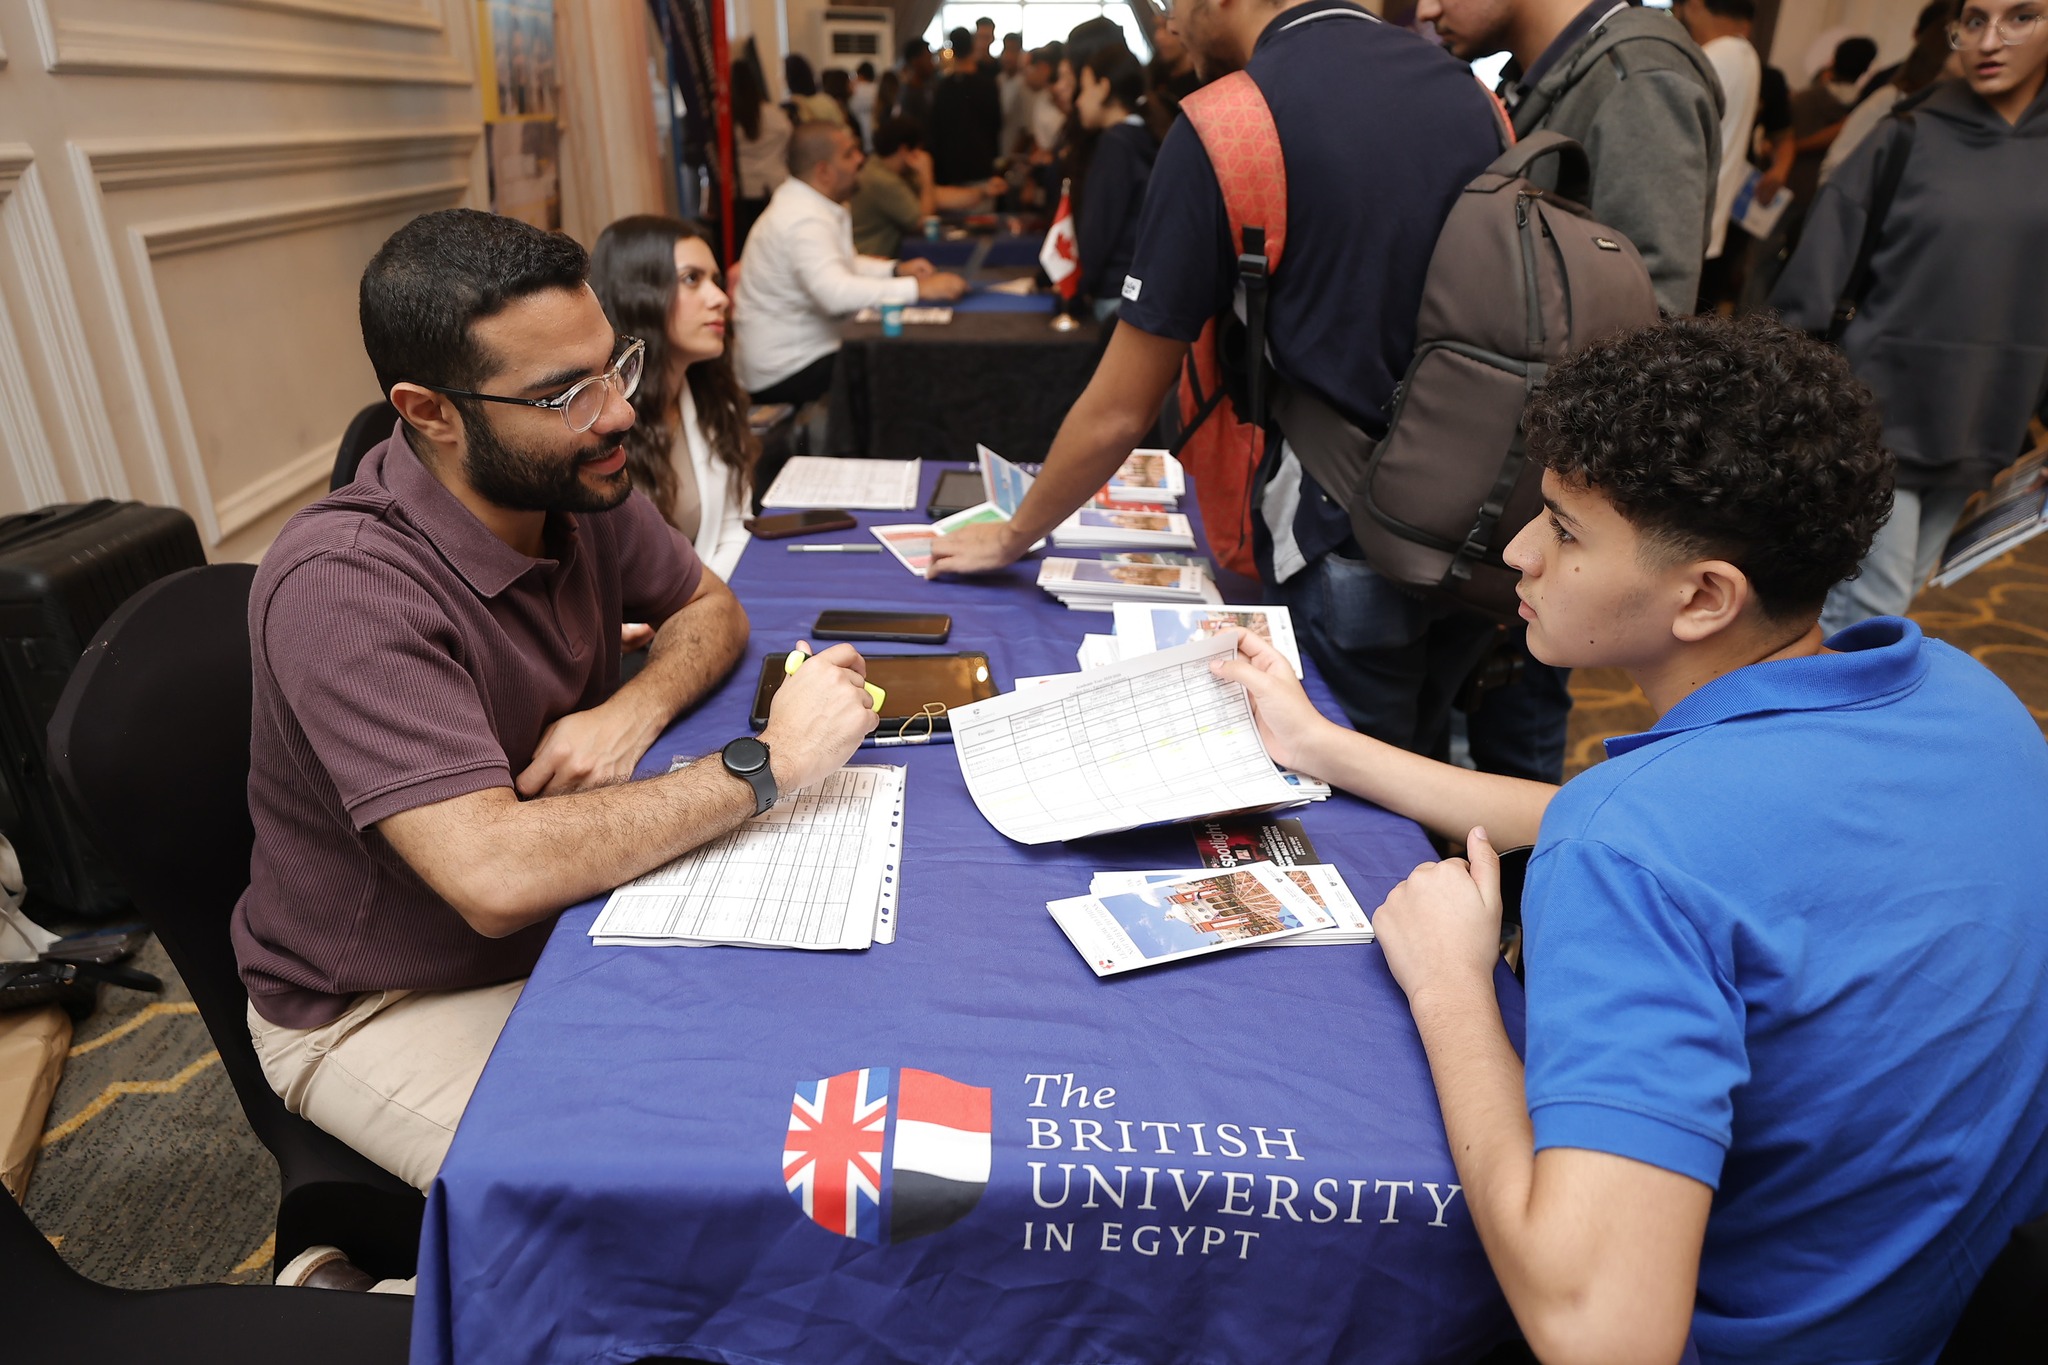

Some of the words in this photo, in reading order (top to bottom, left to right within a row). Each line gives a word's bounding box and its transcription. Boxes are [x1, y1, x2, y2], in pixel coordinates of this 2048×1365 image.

[1205, 824, 1238, 867] spotlight
[1024, 1072, 1117, 1110] The
[1026, 1118, 1306, 1162] BRITISH
[1027, 1162, 1463, 1228] UNIVERSITY
[1023, 1222, 1075, 1252] IN
[1101, 1223, 1260, 1260] EGYPT
